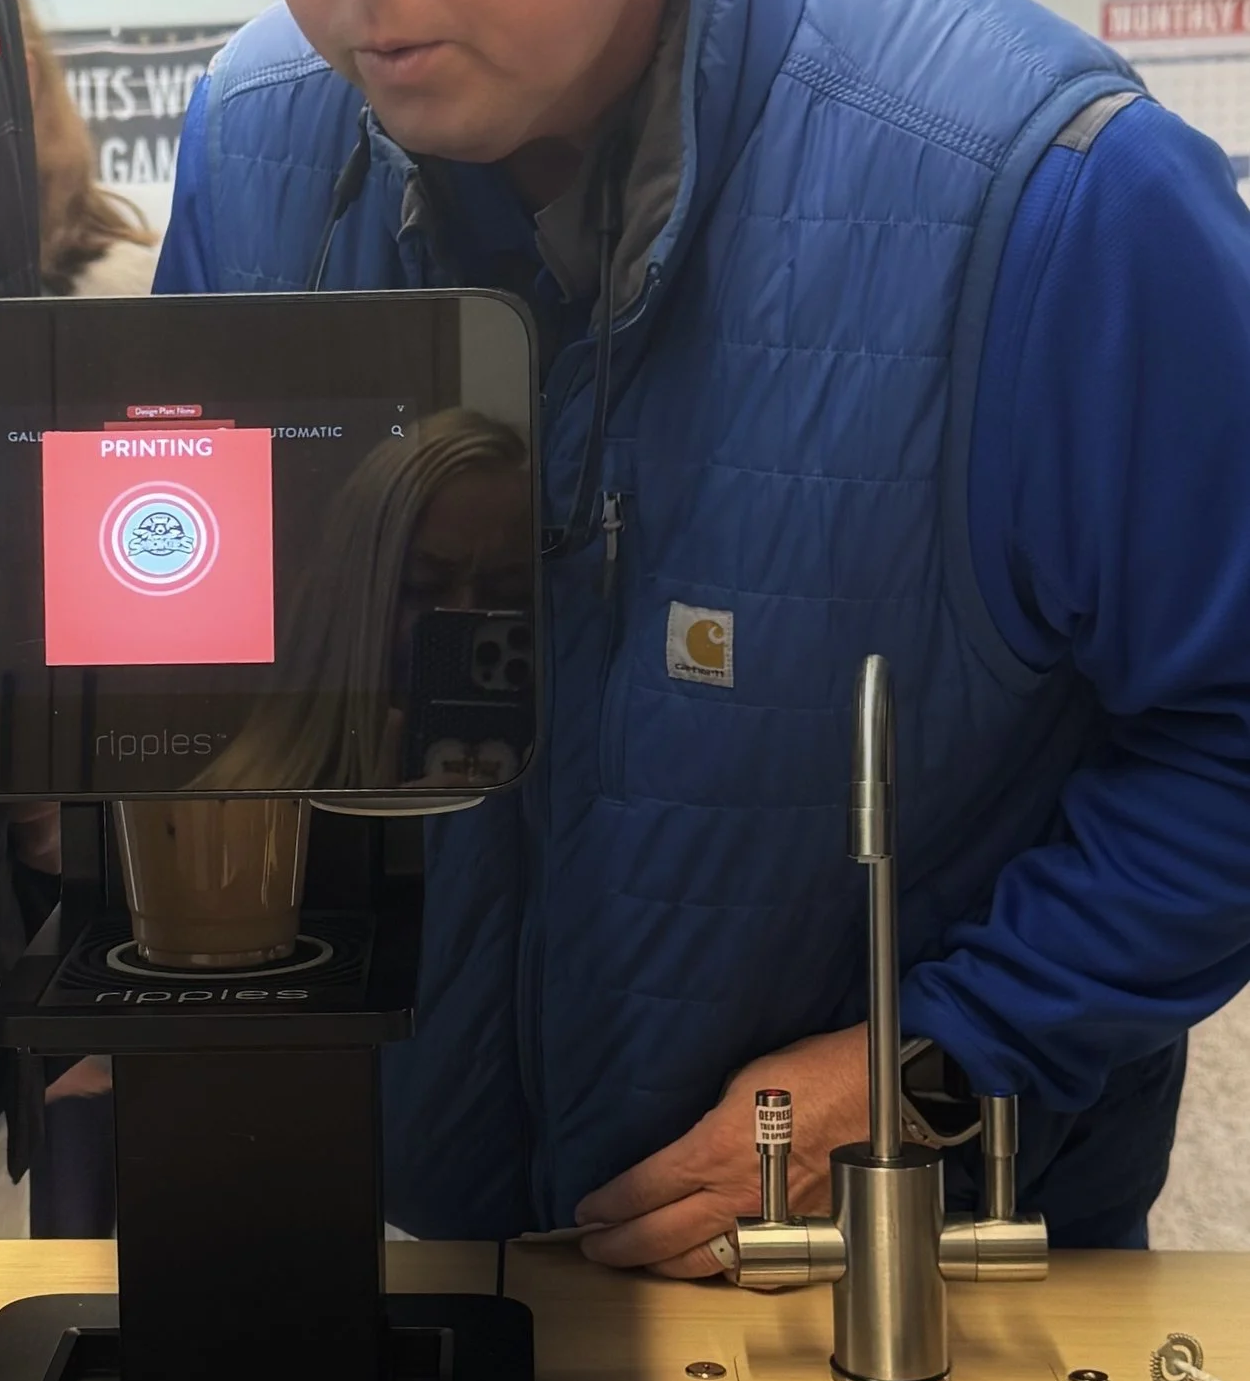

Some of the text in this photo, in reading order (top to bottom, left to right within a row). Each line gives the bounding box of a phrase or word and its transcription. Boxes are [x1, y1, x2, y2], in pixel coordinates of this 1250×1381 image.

[100, 437, 214, 458] PRINTING
[95, 988, 310, 1004] ripples
[759, 1109, 791, 1121] DEPRES
